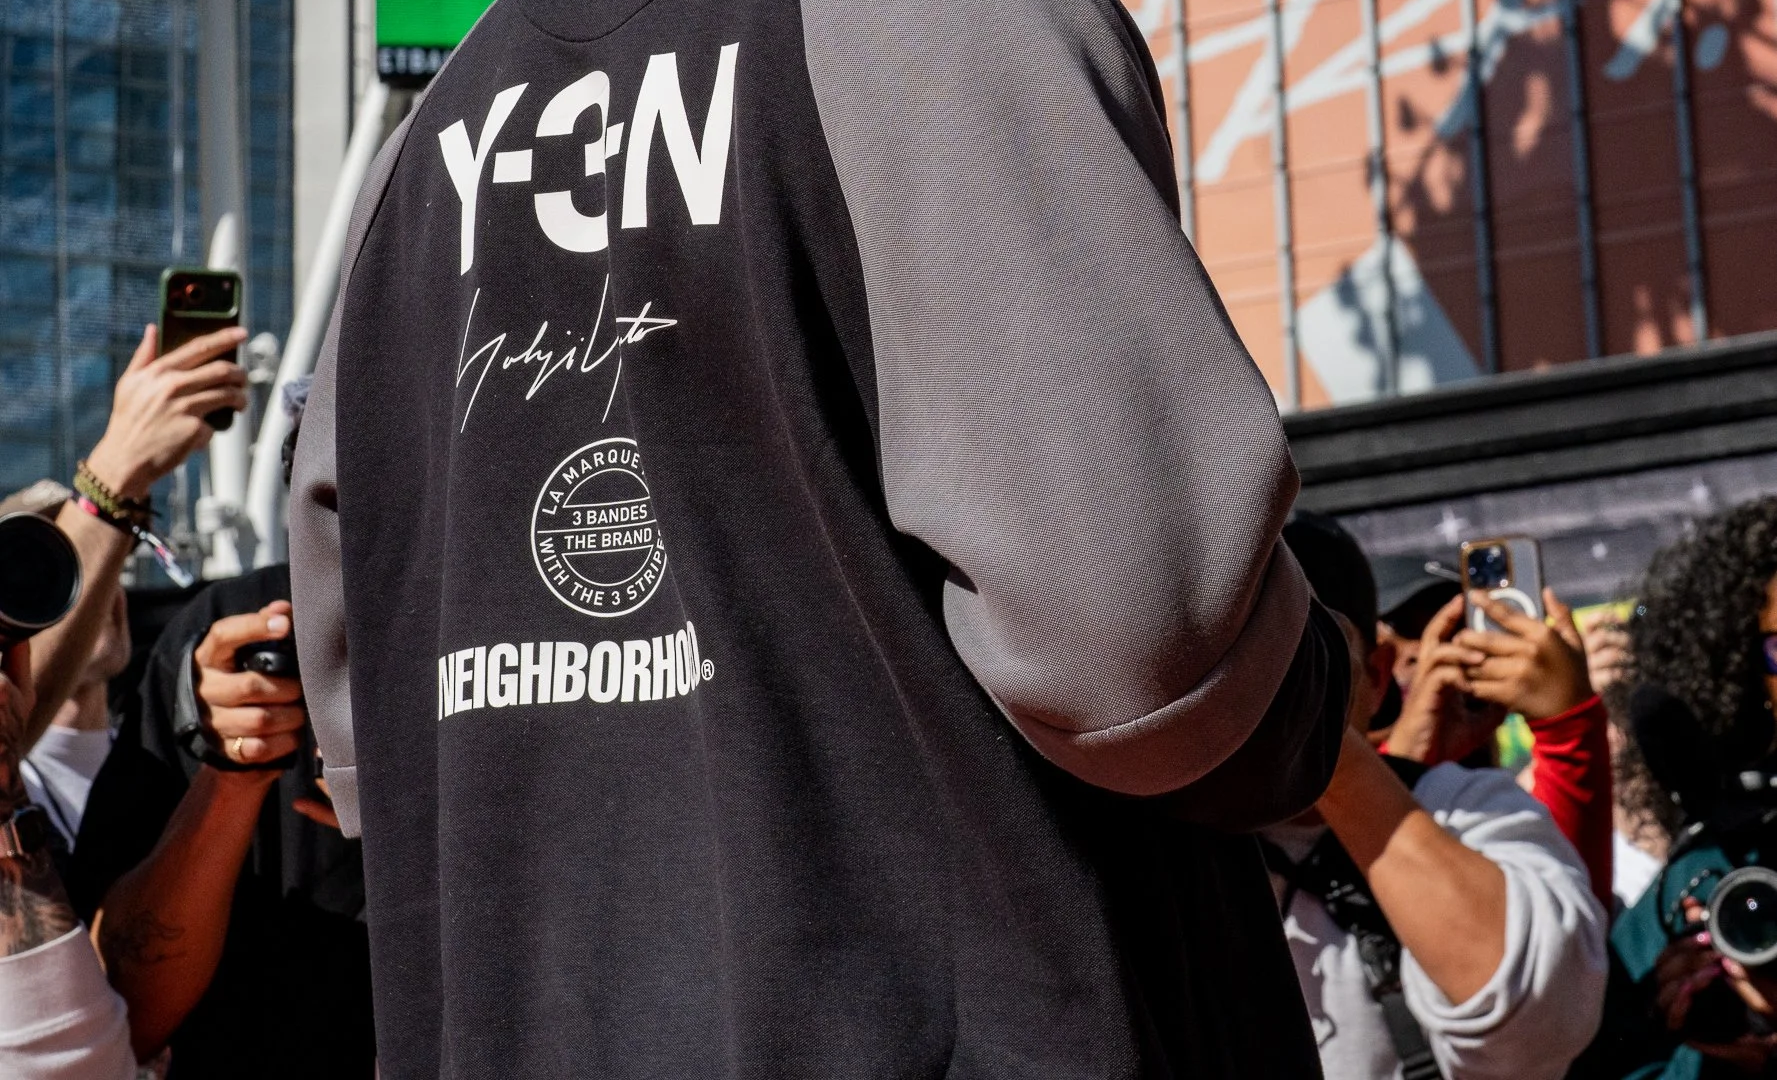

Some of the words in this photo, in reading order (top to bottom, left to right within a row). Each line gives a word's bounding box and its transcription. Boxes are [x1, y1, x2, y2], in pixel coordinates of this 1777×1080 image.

[542, 490, 565, 515] LA
[562, 449, 640, 484] MARQUE
[572, 510, 582, 525] 3
[586, 504, 648, 525] BANDES
[564, 533, 597, 550] THE
[601, 527, 652, 548] BRAND
[539, 537, 570, 586] WITH
[570, 581, 605, 606] THE
[611, 590, 621, 606] 3
[626, 531, 665, 600] STRIPE
